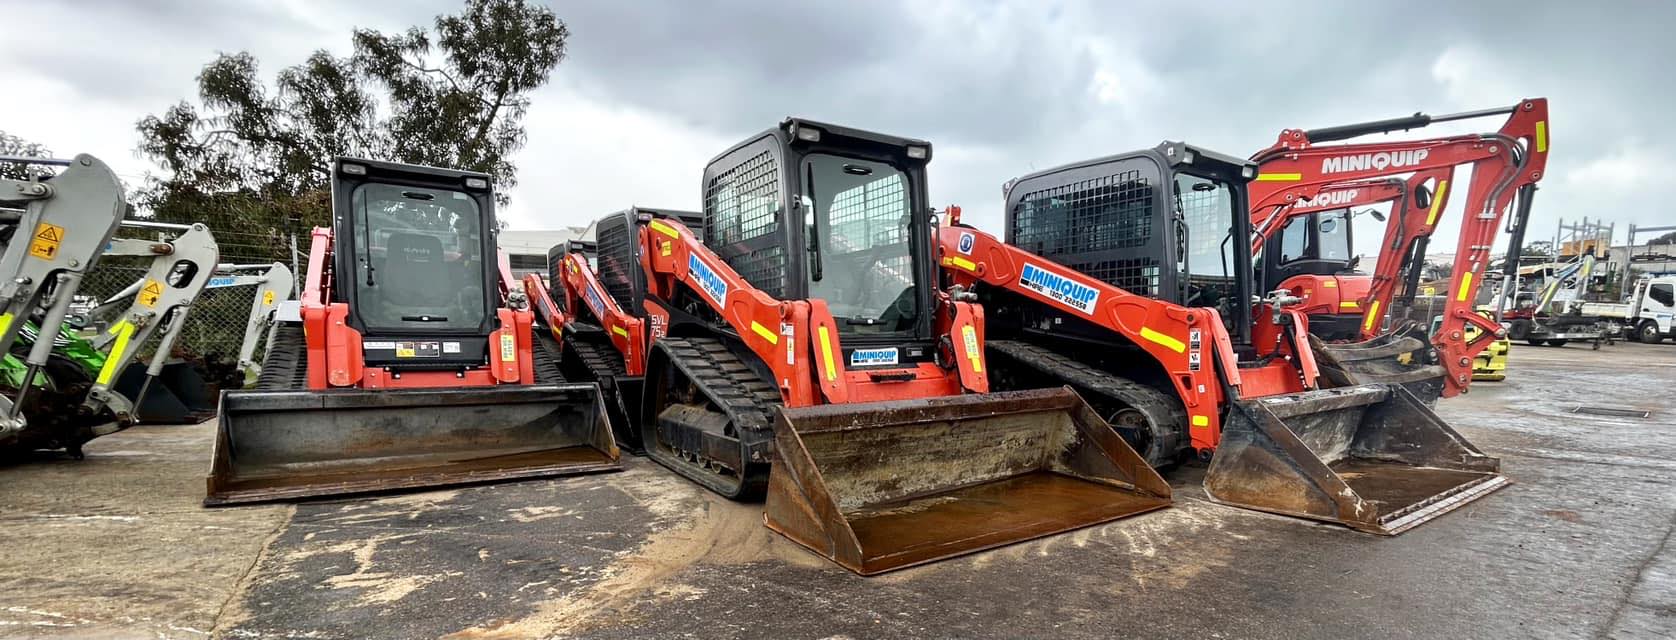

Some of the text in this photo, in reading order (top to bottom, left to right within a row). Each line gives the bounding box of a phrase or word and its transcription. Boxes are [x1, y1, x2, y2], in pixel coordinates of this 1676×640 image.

[1322, 149, 1429, 174] MINIQUIP
[1293, 189, 1359, 208] INIQUIP
[694, 256, 726, 297] MINIQUIP
[1031, 268, 1096, 304] MINIQUIP
[1049, 290, 1063, 300] 1300
[652, 314, 667, 325] SVL
[860, 350, 897, 360] MINIQUIP
